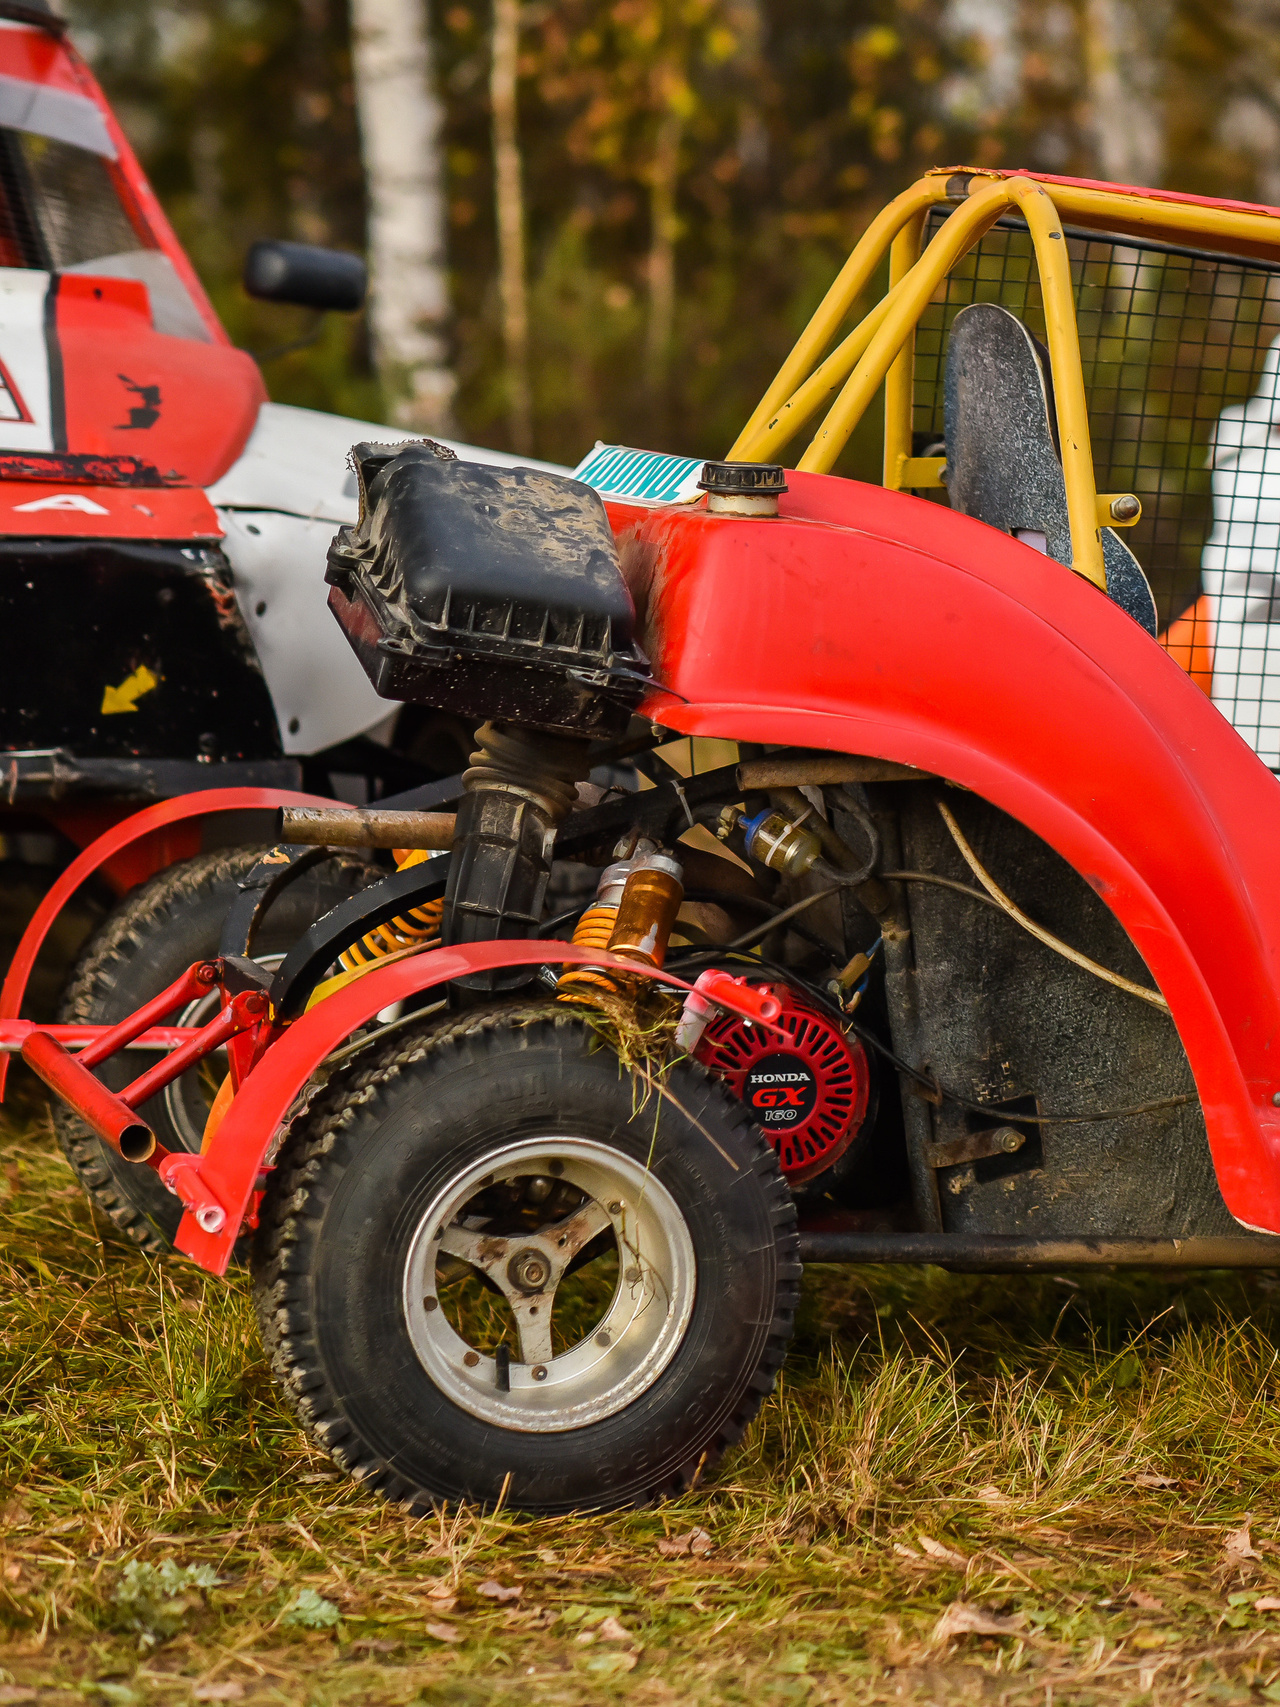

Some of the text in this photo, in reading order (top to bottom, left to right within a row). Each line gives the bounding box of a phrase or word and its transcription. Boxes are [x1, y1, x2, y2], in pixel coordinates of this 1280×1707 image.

[750, 1073, 811, 1083] HONDA
[752, 1086, 808, 1107] GX
[765, 1109, 798, 1121] 160
